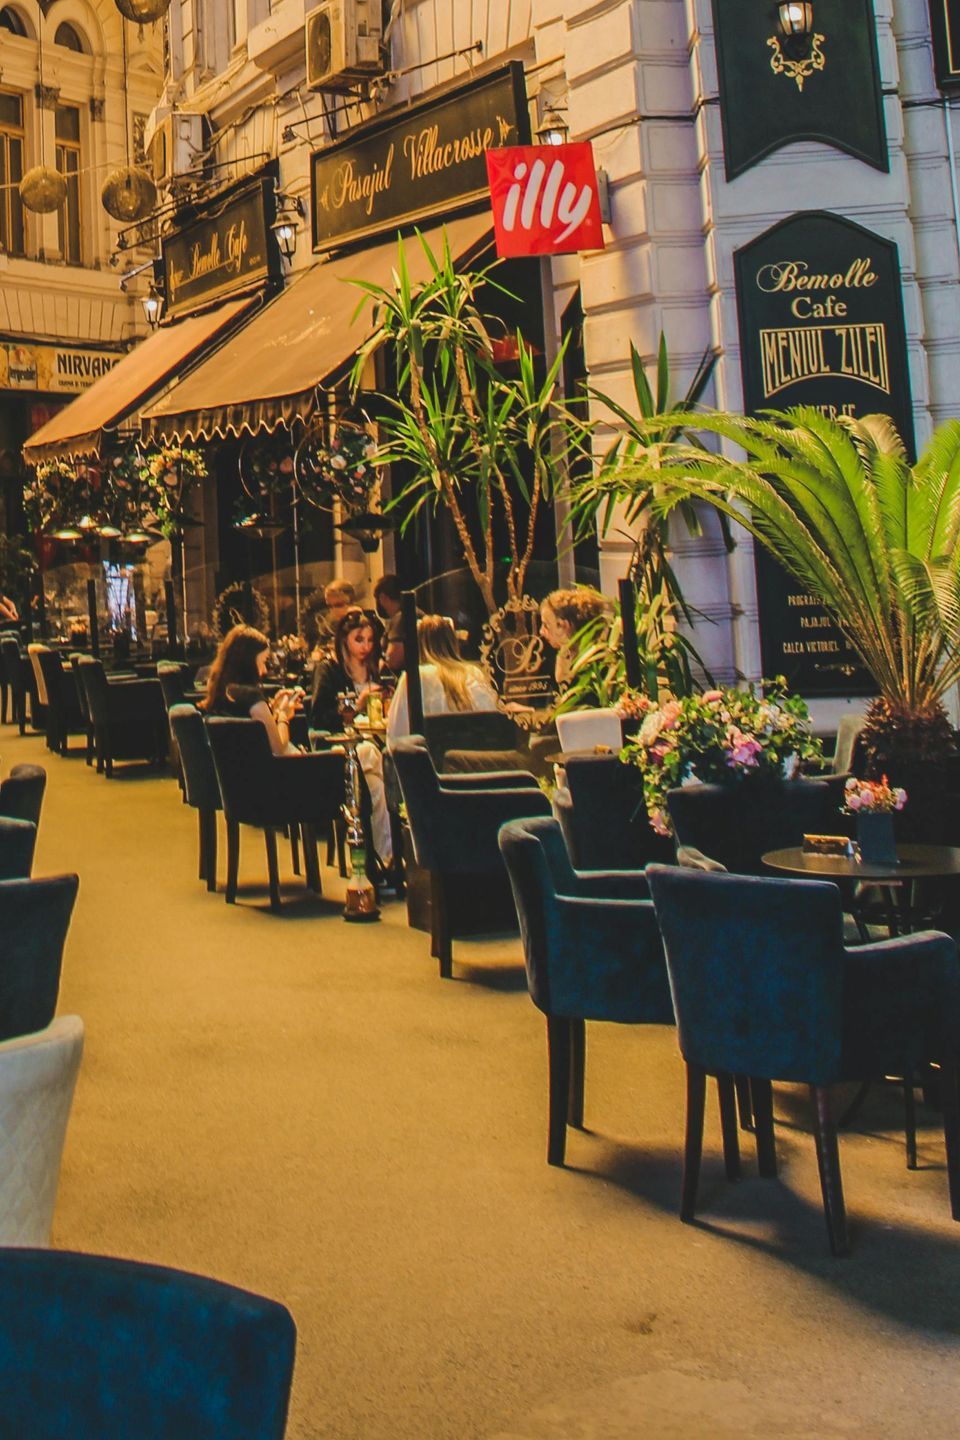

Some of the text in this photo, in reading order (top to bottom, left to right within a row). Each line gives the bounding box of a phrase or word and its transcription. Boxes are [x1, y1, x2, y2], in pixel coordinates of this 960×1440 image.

[330, 124, 494, 215] Pasajul Villacrosse
[503, 159, 592, 244] illy
[756, 258, 878, 293] Bemolle
[792, 295, 848, 319] Cafe
[763, 326, 886, 393] MENIUL ZILEI
